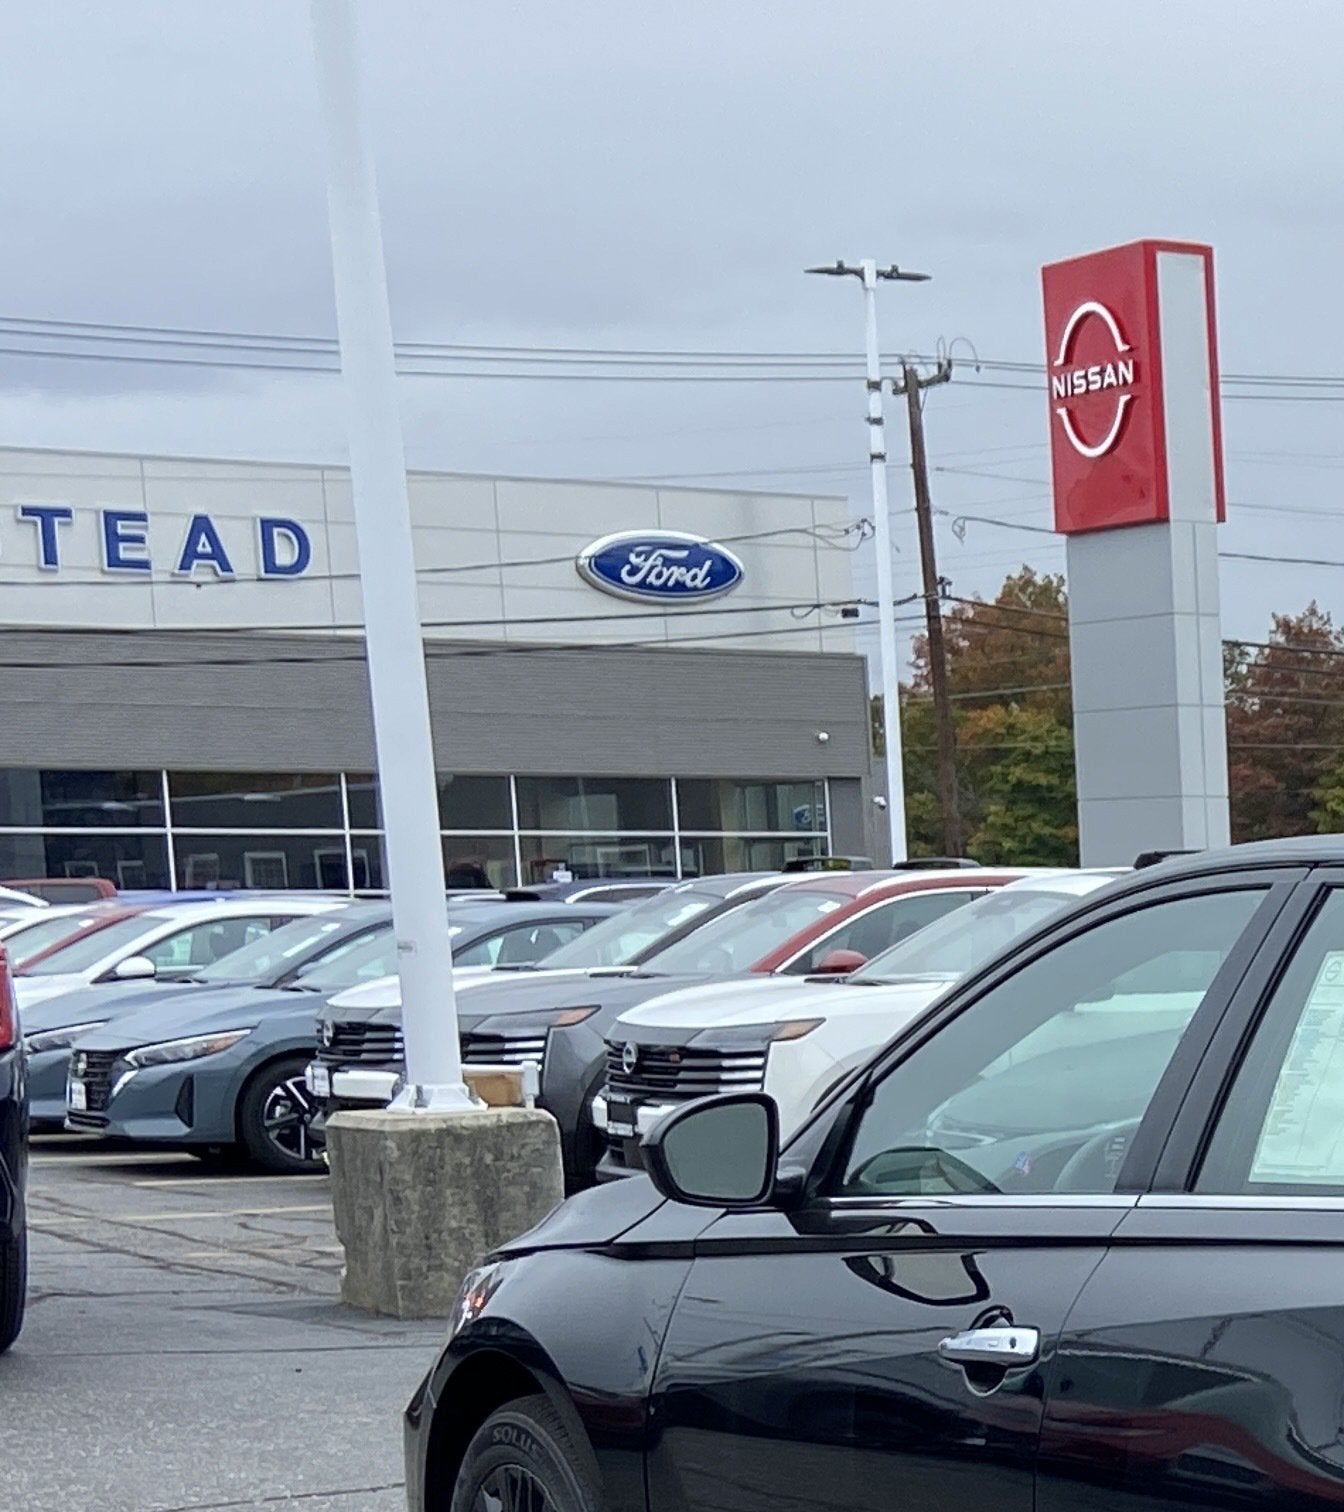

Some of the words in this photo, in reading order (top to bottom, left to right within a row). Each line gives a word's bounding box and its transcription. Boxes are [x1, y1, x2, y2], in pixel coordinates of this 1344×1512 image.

[1052, 359, 1134, 400] NISSAN
[16, 503, 312, 578] TEAD
[620, 546, 712, 589] Ford
